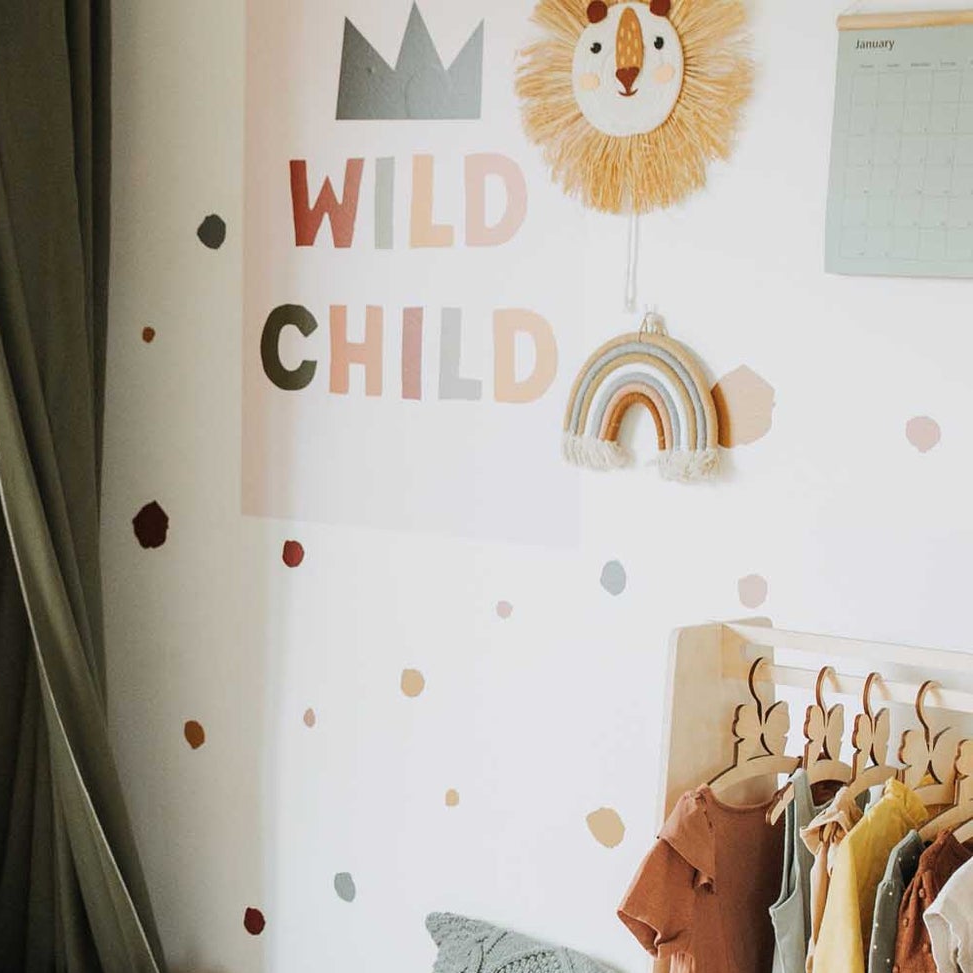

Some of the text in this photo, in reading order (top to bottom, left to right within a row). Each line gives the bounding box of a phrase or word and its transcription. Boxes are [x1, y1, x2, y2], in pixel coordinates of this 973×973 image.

[855, 39, 895, 51] January
[290, 153, 528, 249] WILD
[260, 304, 559, 404] CHILD
